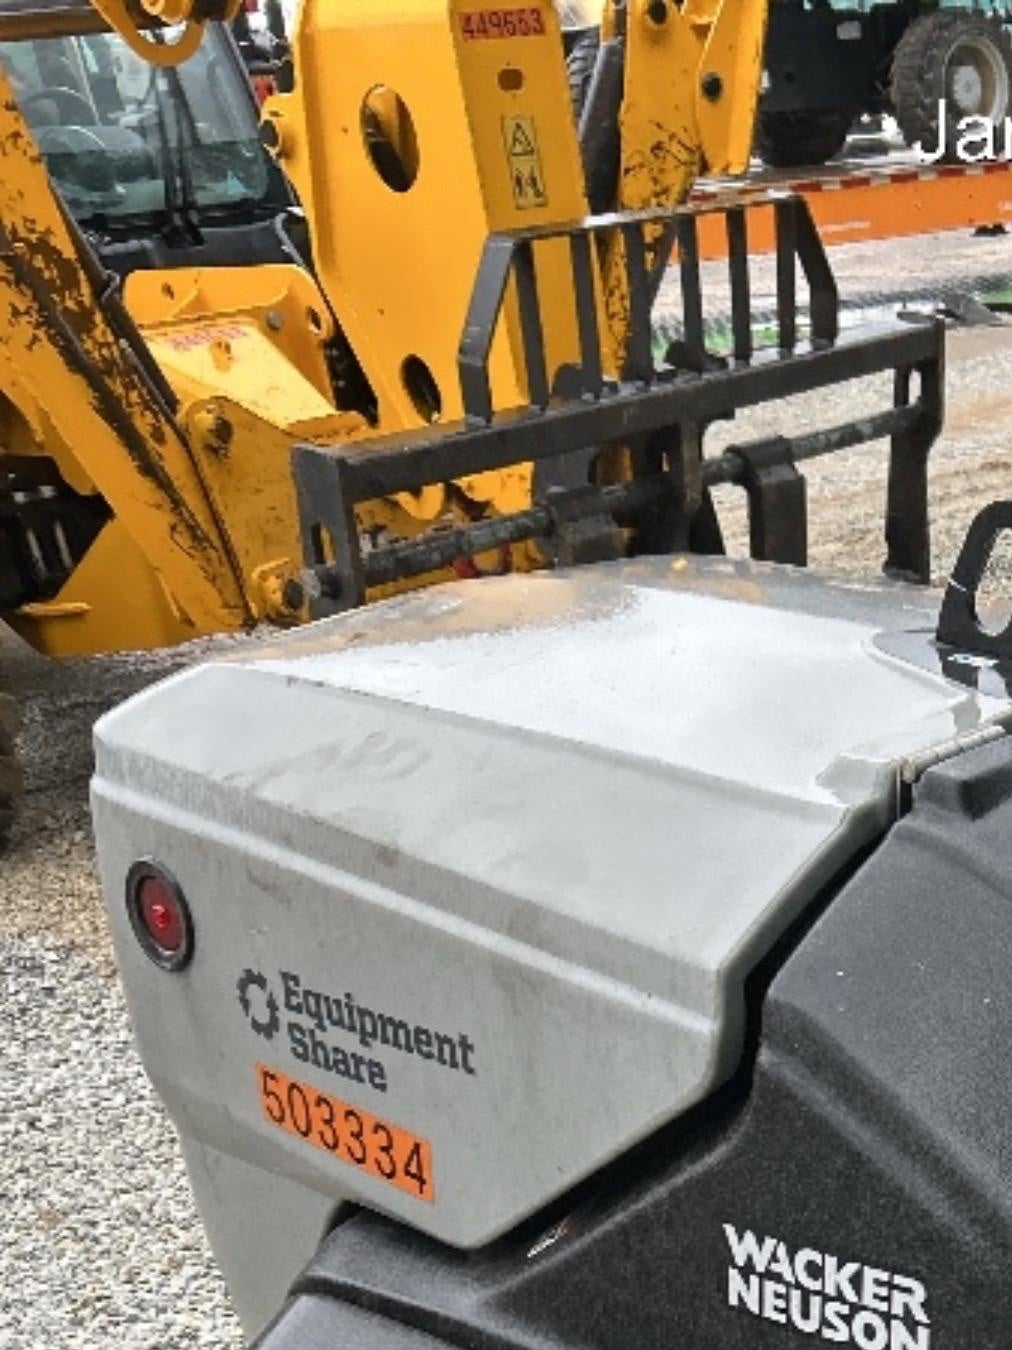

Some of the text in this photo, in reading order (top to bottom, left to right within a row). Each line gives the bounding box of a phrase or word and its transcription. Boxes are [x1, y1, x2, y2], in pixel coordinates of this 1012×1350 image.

[278, 968, 478, 1077] Equipment
[286, 1021, 389, 1093] Share
[262, 1068, 429, 1195] 503334
[722, 1222, 931, 1325] WACKER
